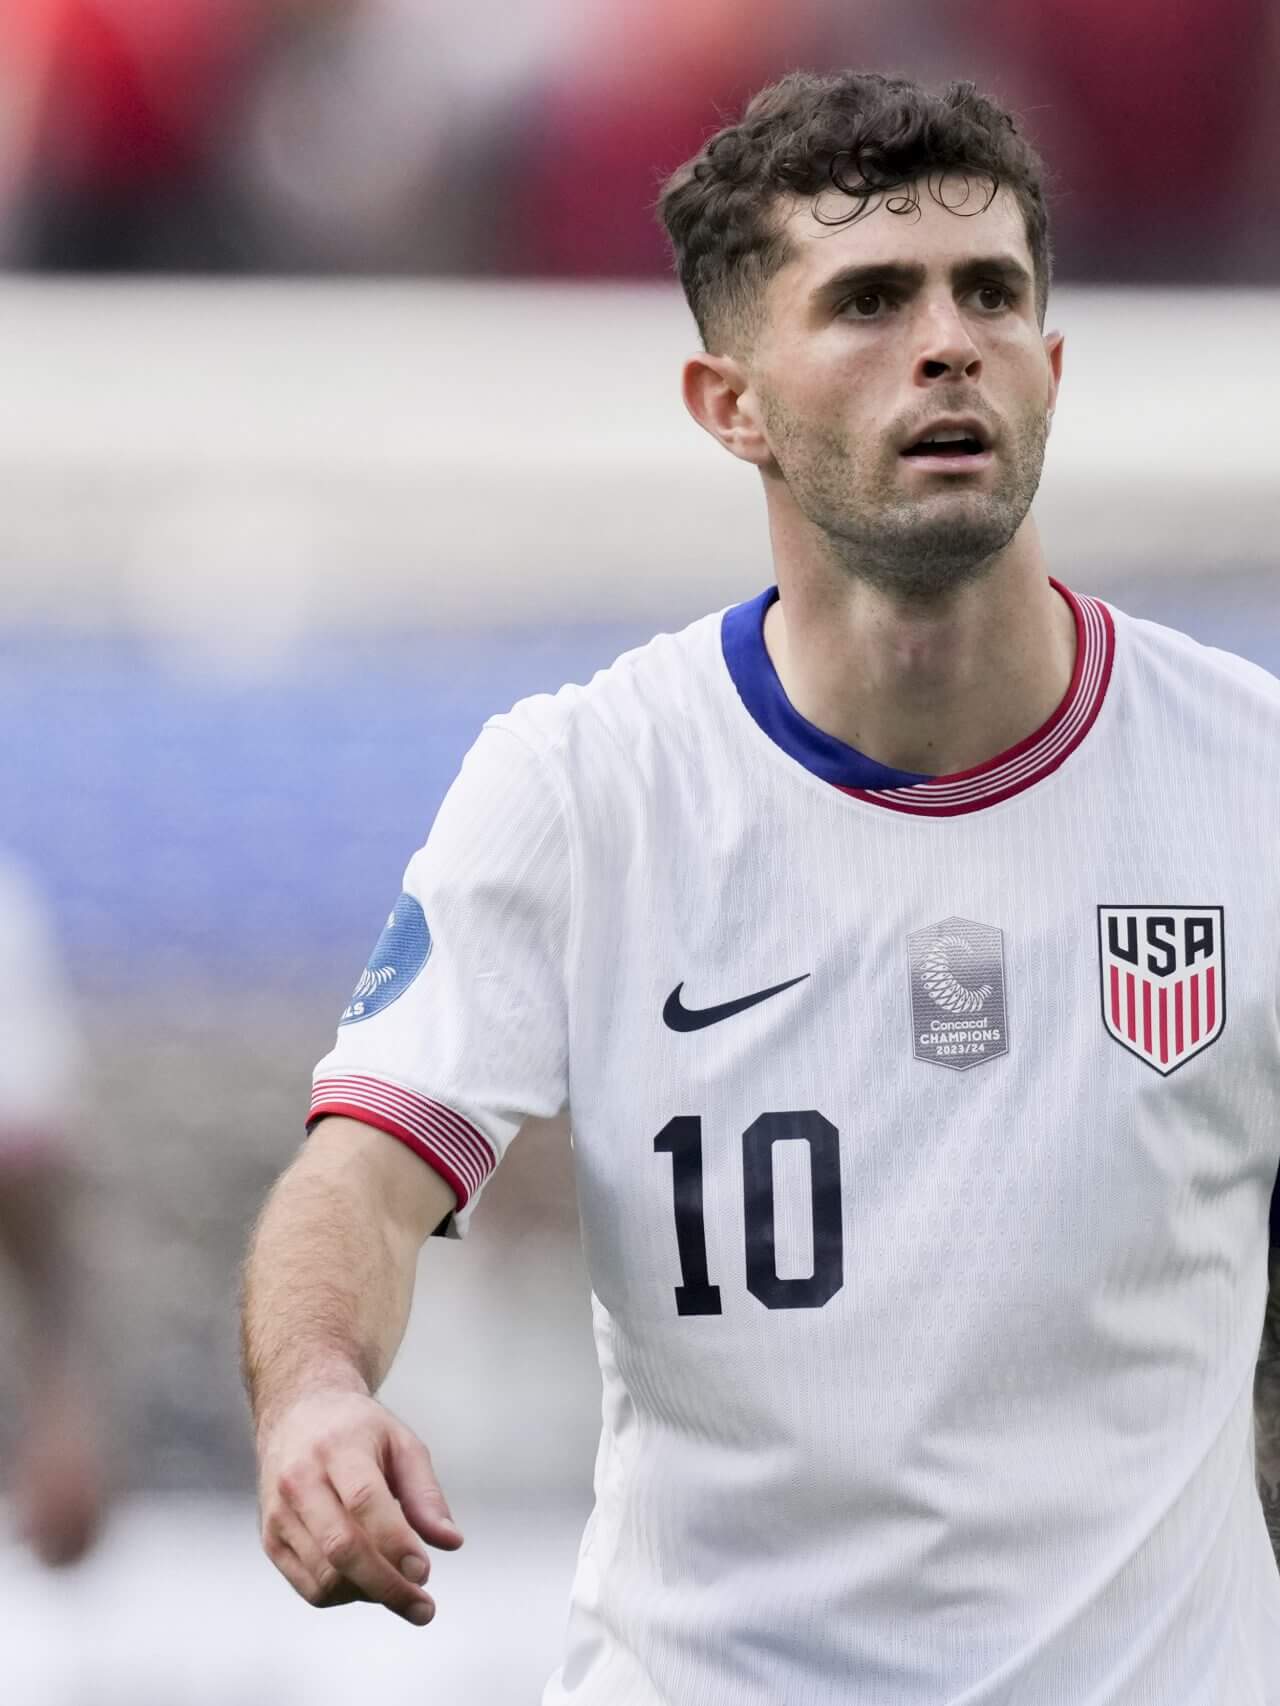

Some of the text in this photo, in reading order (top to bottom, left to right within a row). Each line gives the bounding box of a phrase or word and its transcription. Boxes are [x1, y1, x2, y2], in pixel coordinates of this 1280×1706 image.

[1108, 916, 1214, 977] USA
[930, 1016, 988, 1031] Concacaf
[920, 1029, 1001, 1045] CHAMPIONS
[936, 1043, 985, 1056] 2023/24
[653, 1109, 844, 1317] 10
